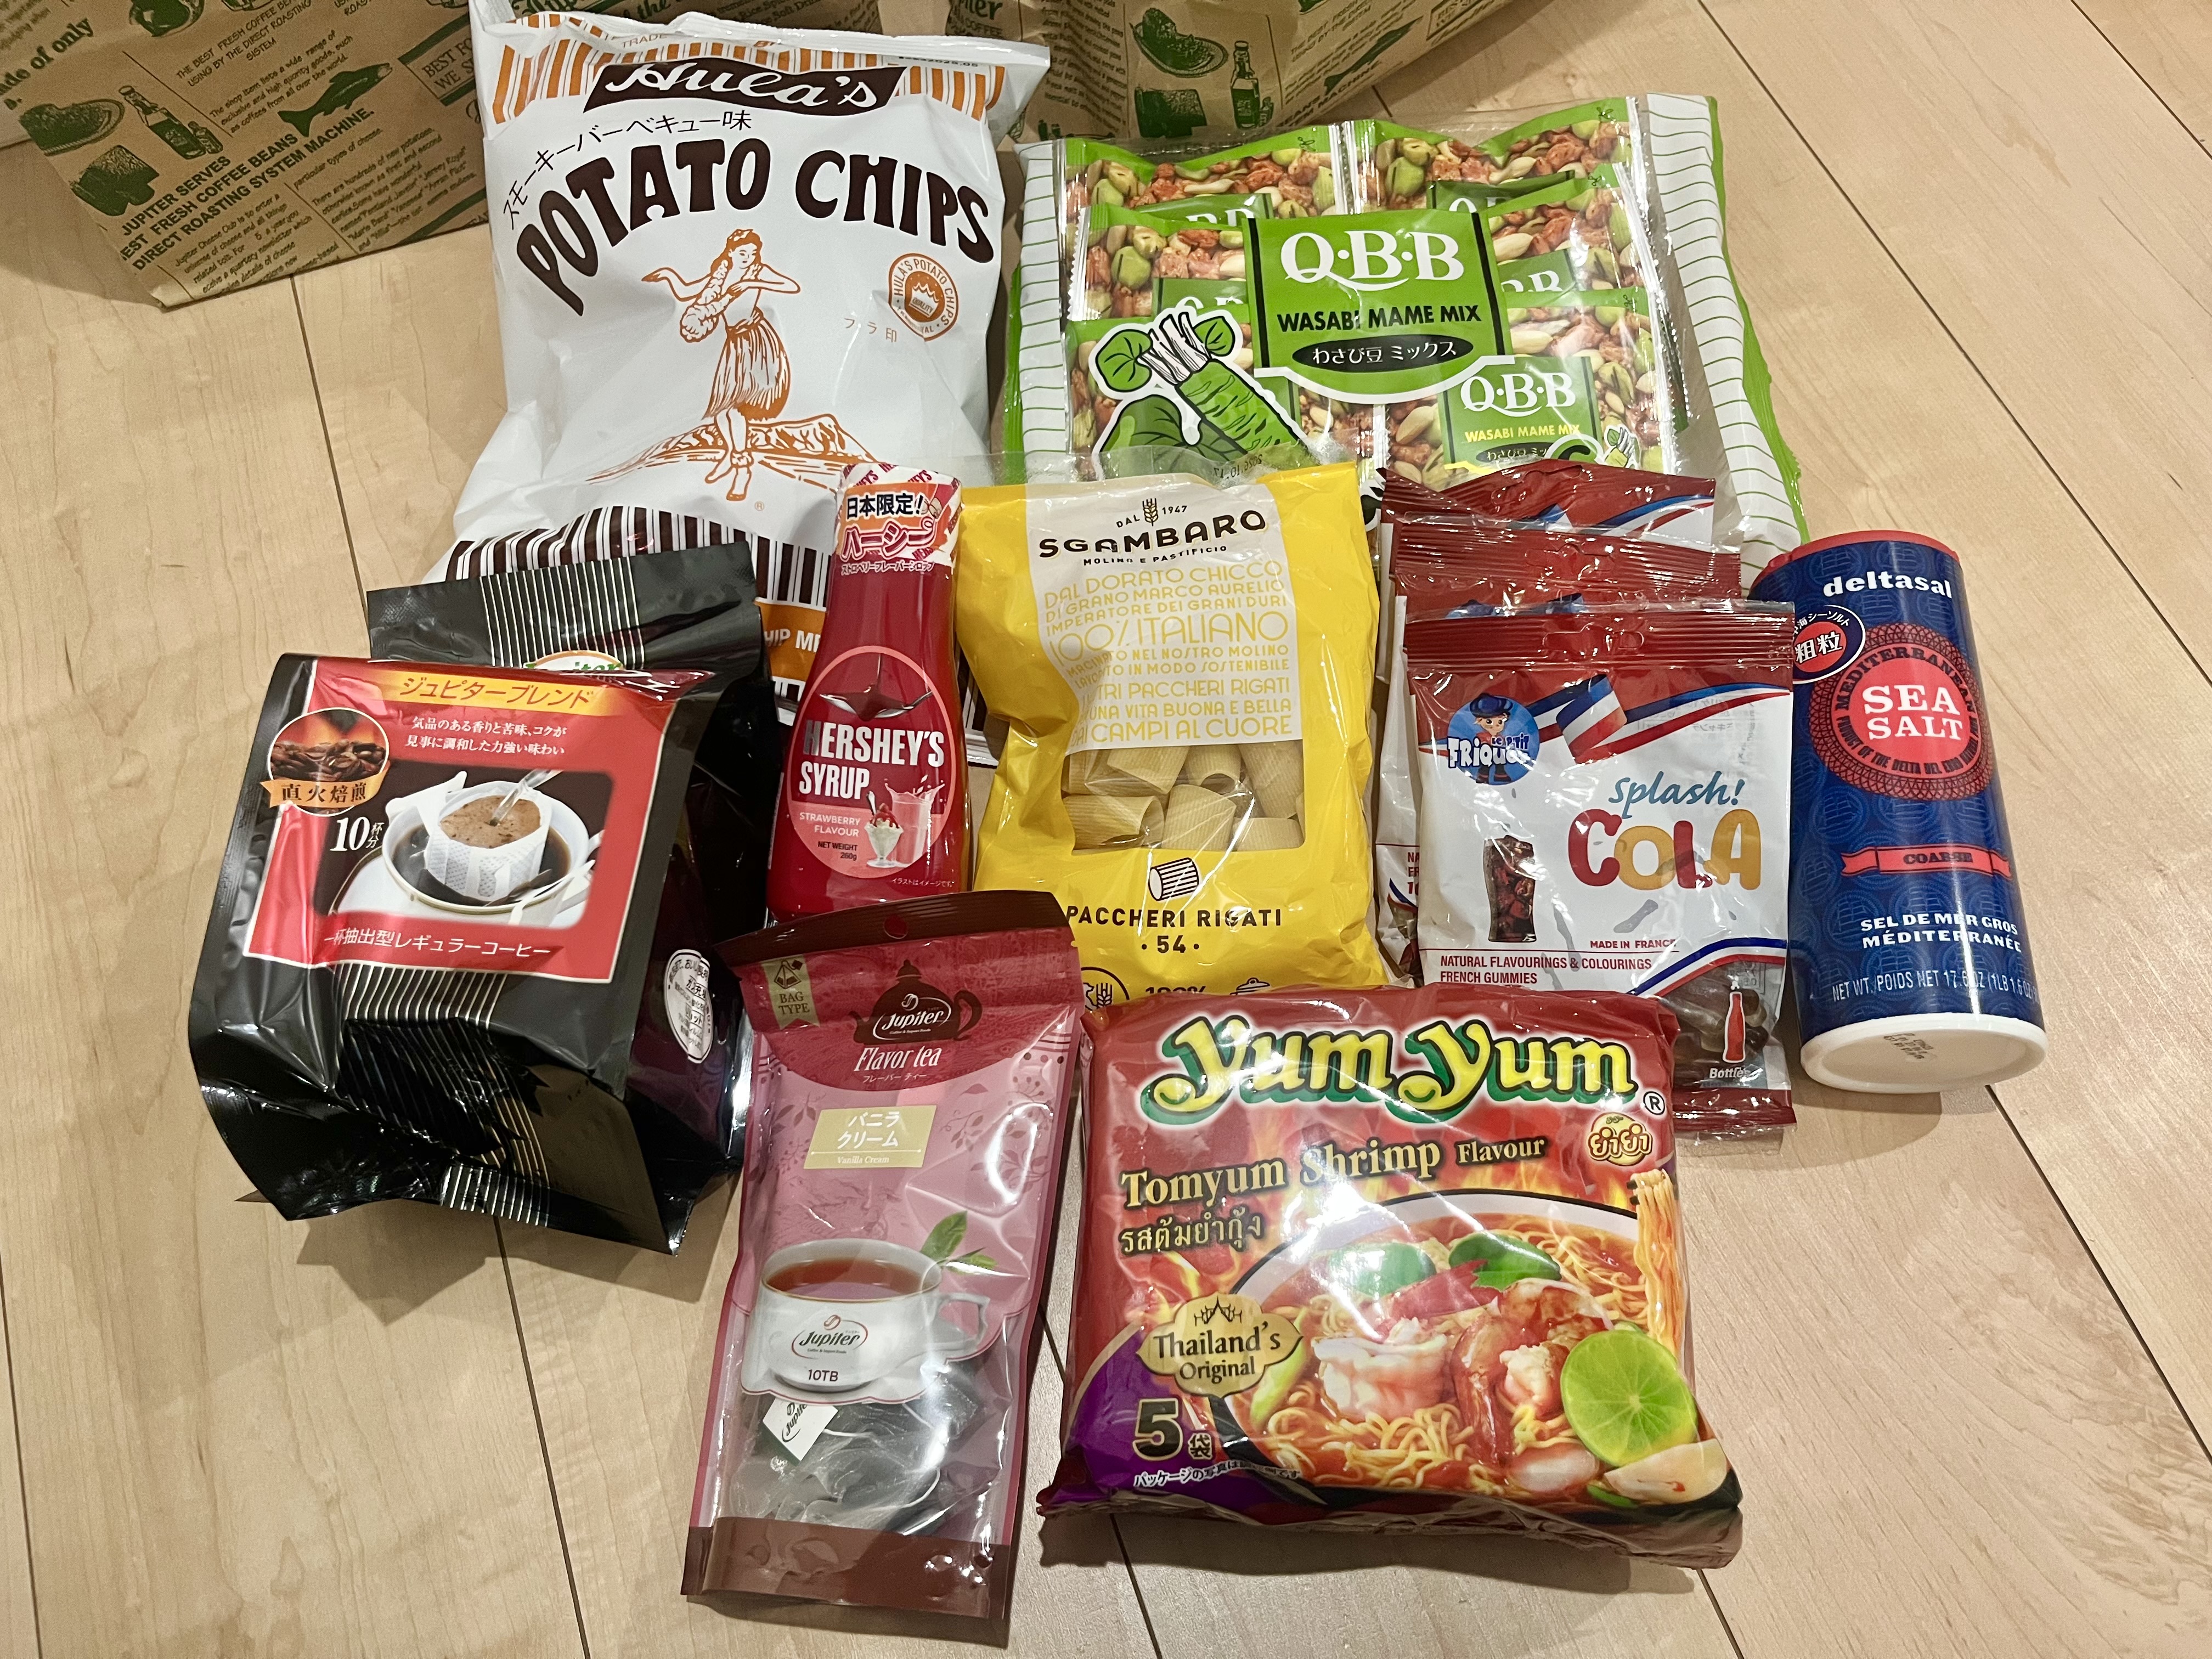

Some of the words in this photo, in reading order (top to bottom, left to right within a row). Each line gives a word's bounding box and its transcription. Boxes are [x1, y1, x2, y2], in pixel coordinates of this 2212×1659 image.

[52, 18, 93, 53] only
[193, 48, 216, 68] BEST
[217, 27, 246, 50] FRESH
[245, 7, 278, 31] COFFEE
[188, 67, 212, 87] USING
[213, 56, 225, 70] BY
[225, 44, 244, 61] THE
[244, 26, 269, 49] DIRECT
[246, 37, 277, 61] SISTEM
[421, 49, 457, 78] BEST
[433, 70, 460, 90] WE
[504, 110, 753, 230] スモーキーバーベキュー味
[121, 235, 148, 261] EST
[151, 200, 198, 236] FRESH
[197, 163, 250, 203] COFFEE
[249, 133, 298, 168] BEANS
[122, 193, 178, 236] JUPITER
[176, 156, 231, 197] SERVES
[133, 232, 183, 270] DIRECT
[184, 187, 251, 236] ROASTING
[250, 146, 307, 189] SYSTEM
[307, 108, 375, 154] MACHINE.
[516, 138, 771, 315] POTATO
[795, 150, 994, 263] CHIPS
[894, 259, 913, 297] HULA'S
[913, 258, 947, 285] POTATO
[940, 287, 953, 325] CHIPS
[1277, 308, 1361, 332] WASABI
[1369, 305, 1434, 329] MAME
[1441, 304, 1481, 323] MIX
[1312, 346, 1383, 364] わさび豆
[1391, 341, 1457, 360] ミックス
[1465, 427, 1514, 443] WASABI
[1518, 425, 1556, 438] MAME
[847, 493, 924, 520] 日本限定!
[1116, 514, 1141, 528] DAL
[1161, 505, 1188, 515] 1947
[1039, 510, 1267, 558] SGAMBARO
[1083, 557, 1133, 566] MOLINO
[1153, 546, 1227, 563] PASTIFICIO
[1045, 584, 1081, 609] DAL
[1086, 568, 1184, 594] DORATO
[1189, 561, 1283, 583] CHICCO
[1823, 571, 1952, 599] deltasal
[1046, 608, 1061, 623] DI
[1065, 591, 1128, 615] GRANO
[1133, 585, 1203, 601] MARCO
[1209, 579, 1284, 595] AURELIO
[1046, 603, 1152, 637] IMPERATORE
[1157, 601, 1183, 613] DEI
[1188, 597, 1242, 611] GRANI
[1246, 595, 1287, 607] DURI
[764, 628, 791, 646] HIP
[1795, 631, 1843, 664] 粗粒
[1132, 648, 1157, 659] NEL
[1161, 646, 1224, 659] NOSTRO
[1228, 644, 1289, 657] MOLINO
[1128, 664, 1142, 676] IN
[1147, 662, 1197, 675] MODO
[1201, 658, 1290, 673] SOSTENIBILE
[1835, 646, 1976, 712] MEDITERRANEAN
[399, 676, 595, 709] ジュピターブレンド
[1128, 679, 1224, 699] PACCHERI
[1231, 676, 1290, 696] RIGATI
[1861, 685, 1961, 715] SEA
[1125, 703, 1158, 719] VITA
[1163, 701, 1225, 718] BUONA
[1231, 700, 1239, 714] E
[1243, 697, 1292, 714] BELLA
[1091, 720, 1169, 743] CAMPI
[1176, 720, 1201, 739] AL
[1205, 715, 1293, 738] CUORE
[1867, 716, 1963, 741] SALT
[405, 735, 565, 756] 見事に調和した力強い味わい
[803, 719, 945, 768] HERSHEY'S
[280, 782, 366, 803] 直火焙煎
[799, 761, 870, 800] SYRUP
[1608, 770, 1745, 819] Splash!
[799, 811, 861, 826] STRAWBERRY
[814, 825, 859, 837] FLAVOUR
[817, 840, 831, 849] NET
[832, 842, 857, 851] WEIGHT
[840, 851, 857, 861] 260g
[1567, 808, 1761, 890] COLA
[1903, 853, 1973, 865] COARSE
[1066, 906, 1186, 928] PACCHERI
[1197, 909, 1282, 927] RIGATI
[1860, 916, 1899, 932] SEL
[1903, 913, 1930, 925] DE
[1935, 913, 1978, 926] MER
[1981, 915, 2018, 935] GROS
[324, 927, 551, 957] 一杯抽出型レギュラーコーヒー
[1590, 940, 1616, 949] MADE
[1620, 940, 1630, 949] IN
[1635, 939, 1677, 949] FRANCE
[1440, 955, 1488, 969] NATURAL
[1490, 956, 1569, 970] FLAVOURINGS
[1570, 956, 1579, 969] &
[1582, 957, 1652, 970] COLOURINGS
[1440, 971, 1483, 984] FRENCH
[1485, 971, 1538, 984] GUMMIES
[1832, 982, 1850, 1002] NET
[1917, 969, 1939, 988] NET
[778, 1002, 810, 1014] TYPE
[780, 992, 804, 1004] BAG
[881, 1011, 944, 1030] Jupiter
[854, 1047, 915, 1071] Flavor
[913, 1046, 943, 1068] tea
[1395, 1015, 1638, 1120] Yum
[848, 1111, 900, 1128] バニラ
[837, 1131, 899, 1149] クリーム
[837, 1156, 863, 1165] Vanilla
[865, 1155, 890, 1164] Cream
[1121, 1156, 1286, 1208] Tomyum
[1300, 1140, 1442, 1187] Shrimp
[1459, 1136, 1549, 1167] Flavour
[799, 1331, 861, 1347] Jupiter
[1153, 1322, 1281, 1359] Thailand's
[808, 1369, 838, 1382] 10TB
[1179, 1357, 1256, 1384] Original
